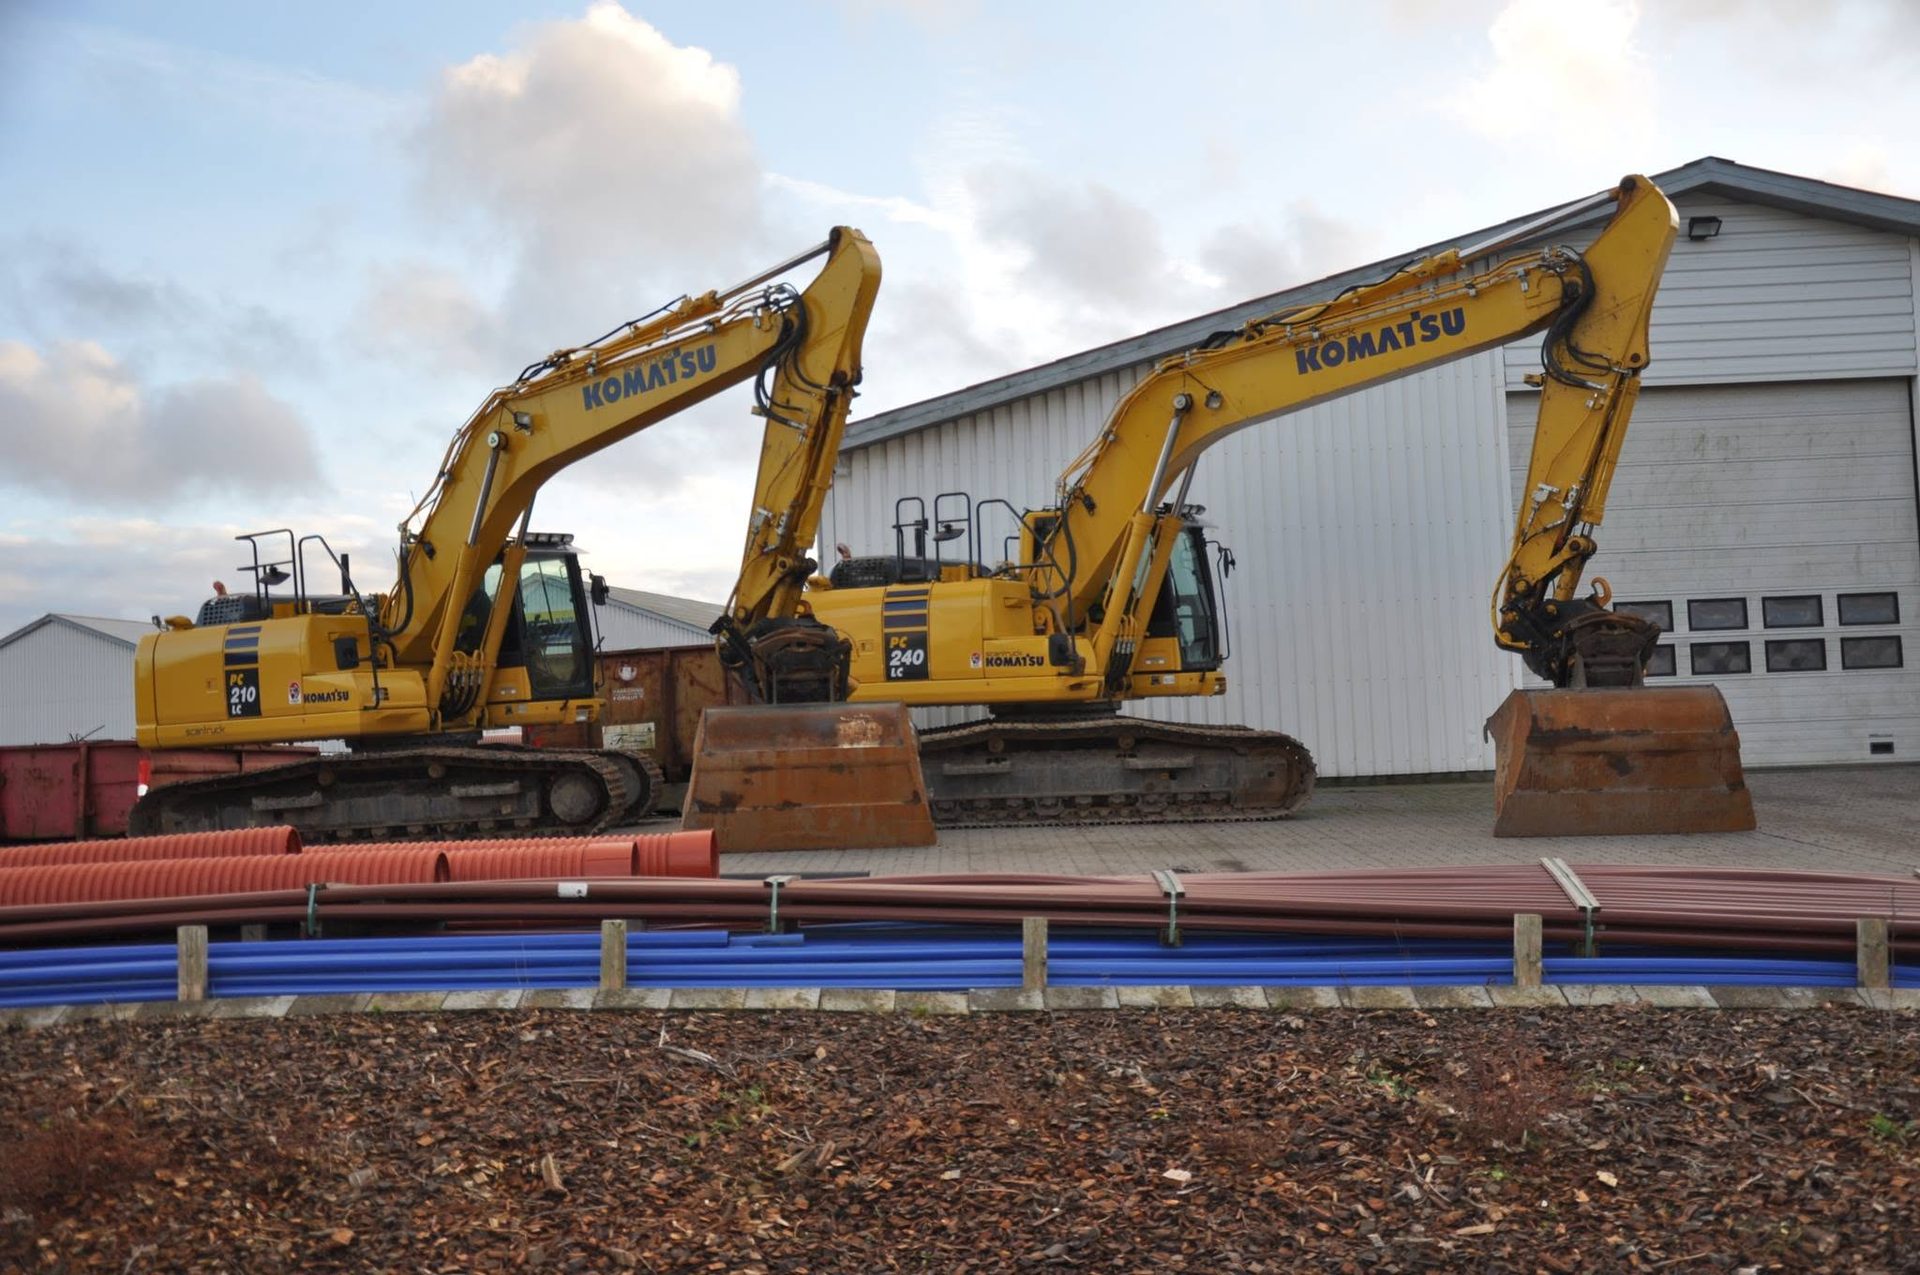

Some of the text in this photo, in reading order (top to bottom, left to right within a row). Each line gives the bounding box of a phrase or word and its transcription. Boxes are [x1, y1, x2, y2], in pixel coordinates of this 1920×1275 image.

[1295, 307, 1466, 375] KOMATSU
[582, 344, 716, 411] KOMATSU
[890, 636, 908, 649] PC
[889, 649, 925, 666] 240
[985, 654, 1044, 667] KOMATSU
[229, 673, 244, 685] PC
[890, 667, 904, 678] LC
[230, 686, 256, 703] 210
[303, 689, 349, 704] KOMATSU
[231, 705, 242, 715] LC
